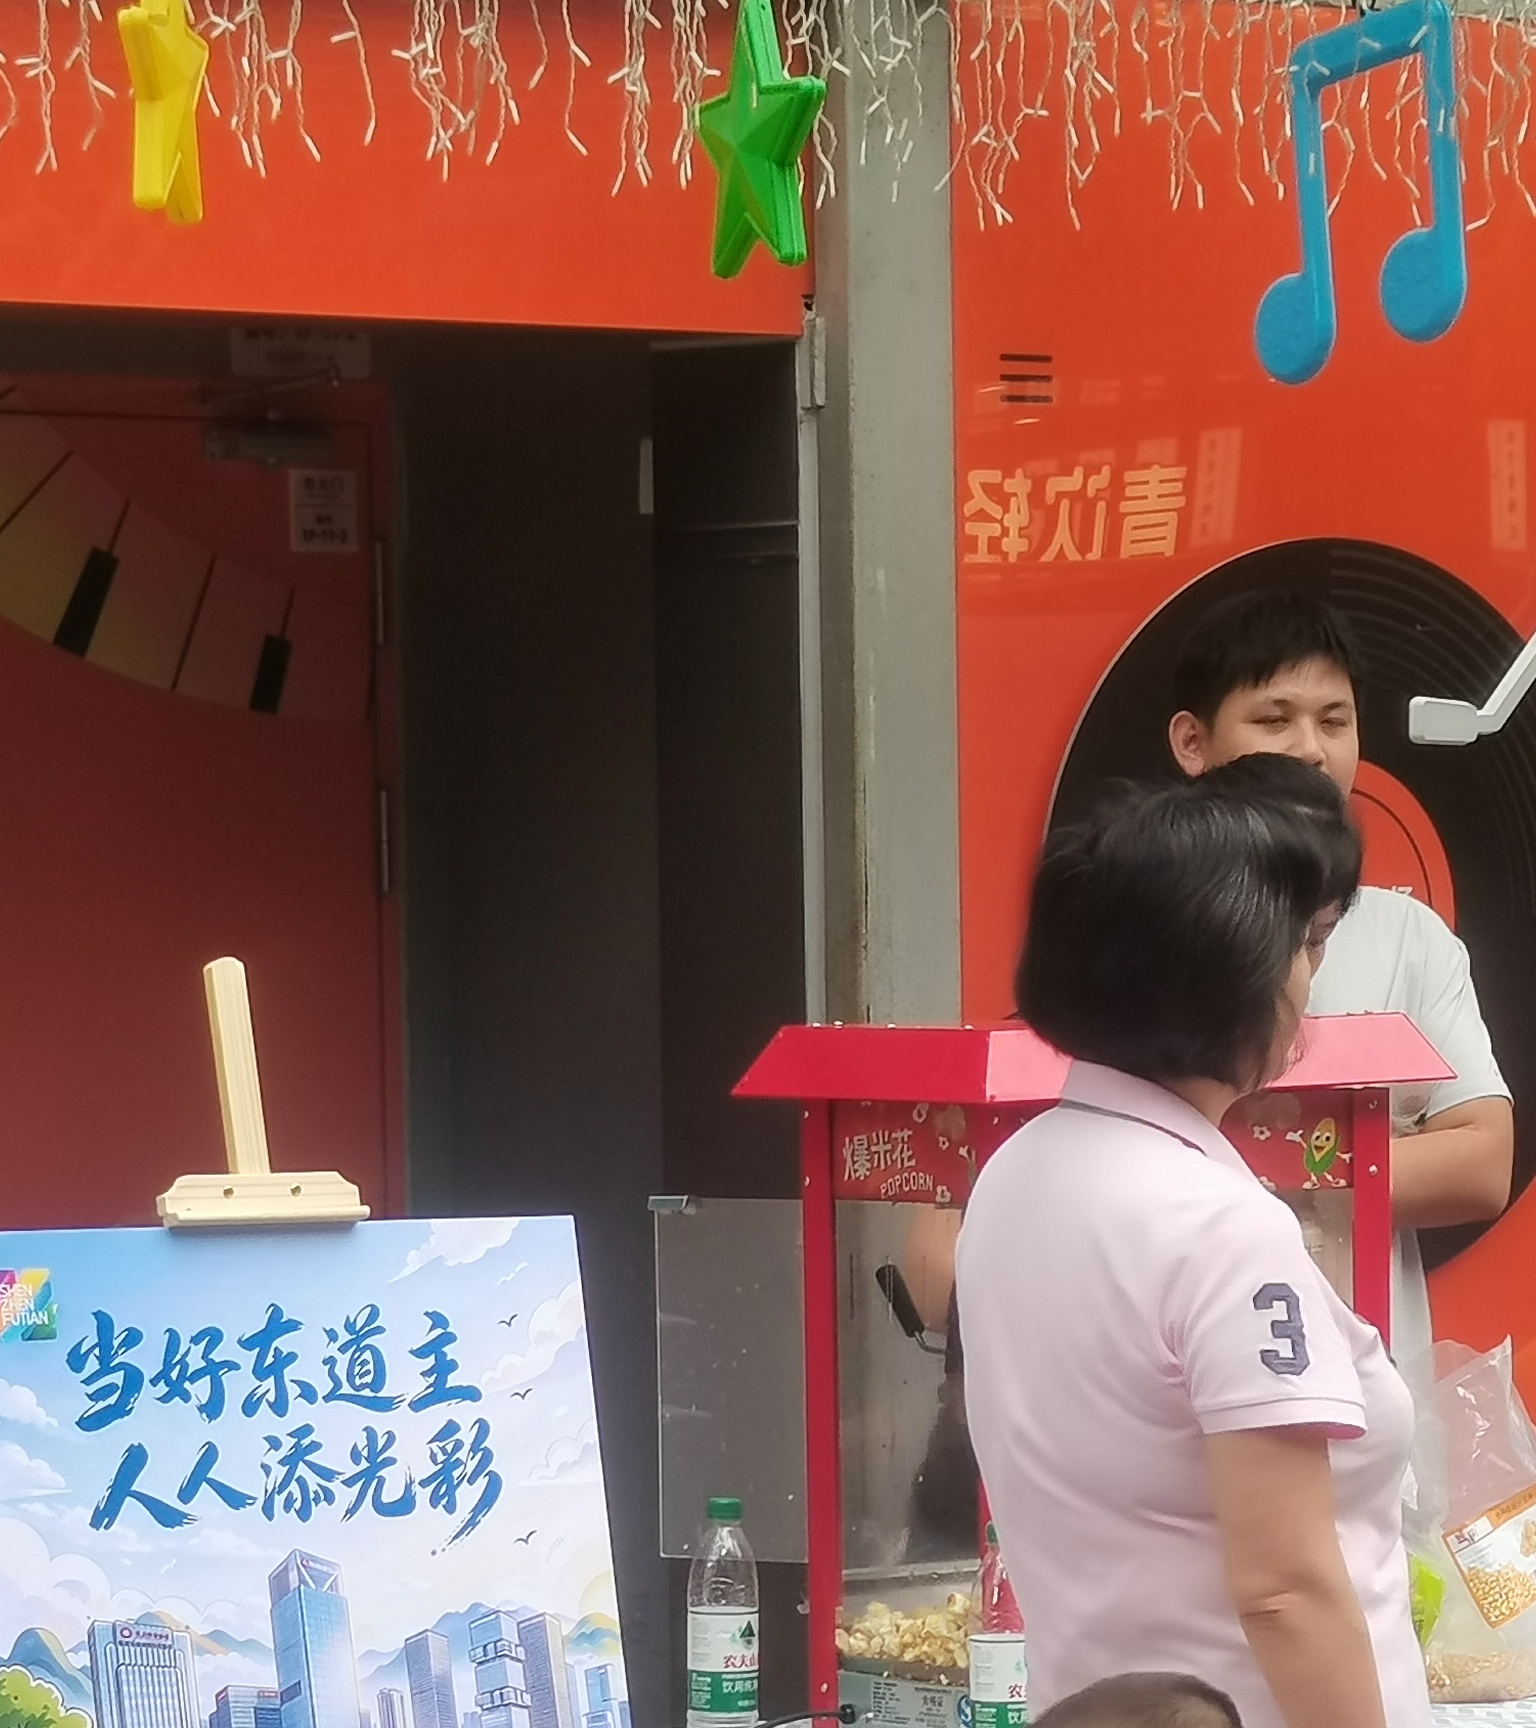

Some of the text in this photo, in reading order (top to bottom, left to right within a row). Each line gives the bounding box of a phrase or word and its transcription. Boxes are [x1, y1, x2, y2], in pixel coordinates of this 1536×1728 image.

[842, 1127, 917, 1182] 爆米花
[879, 1171, 934, 1199] POPCORN
[1, 1311, 50, 1327] FUTIAN
[1253, 1283, 1310, 1377] 3
[65, 1302, 483, 1432] 当好东道主
[87, 1418, 504, 1556] 人人添光彩
